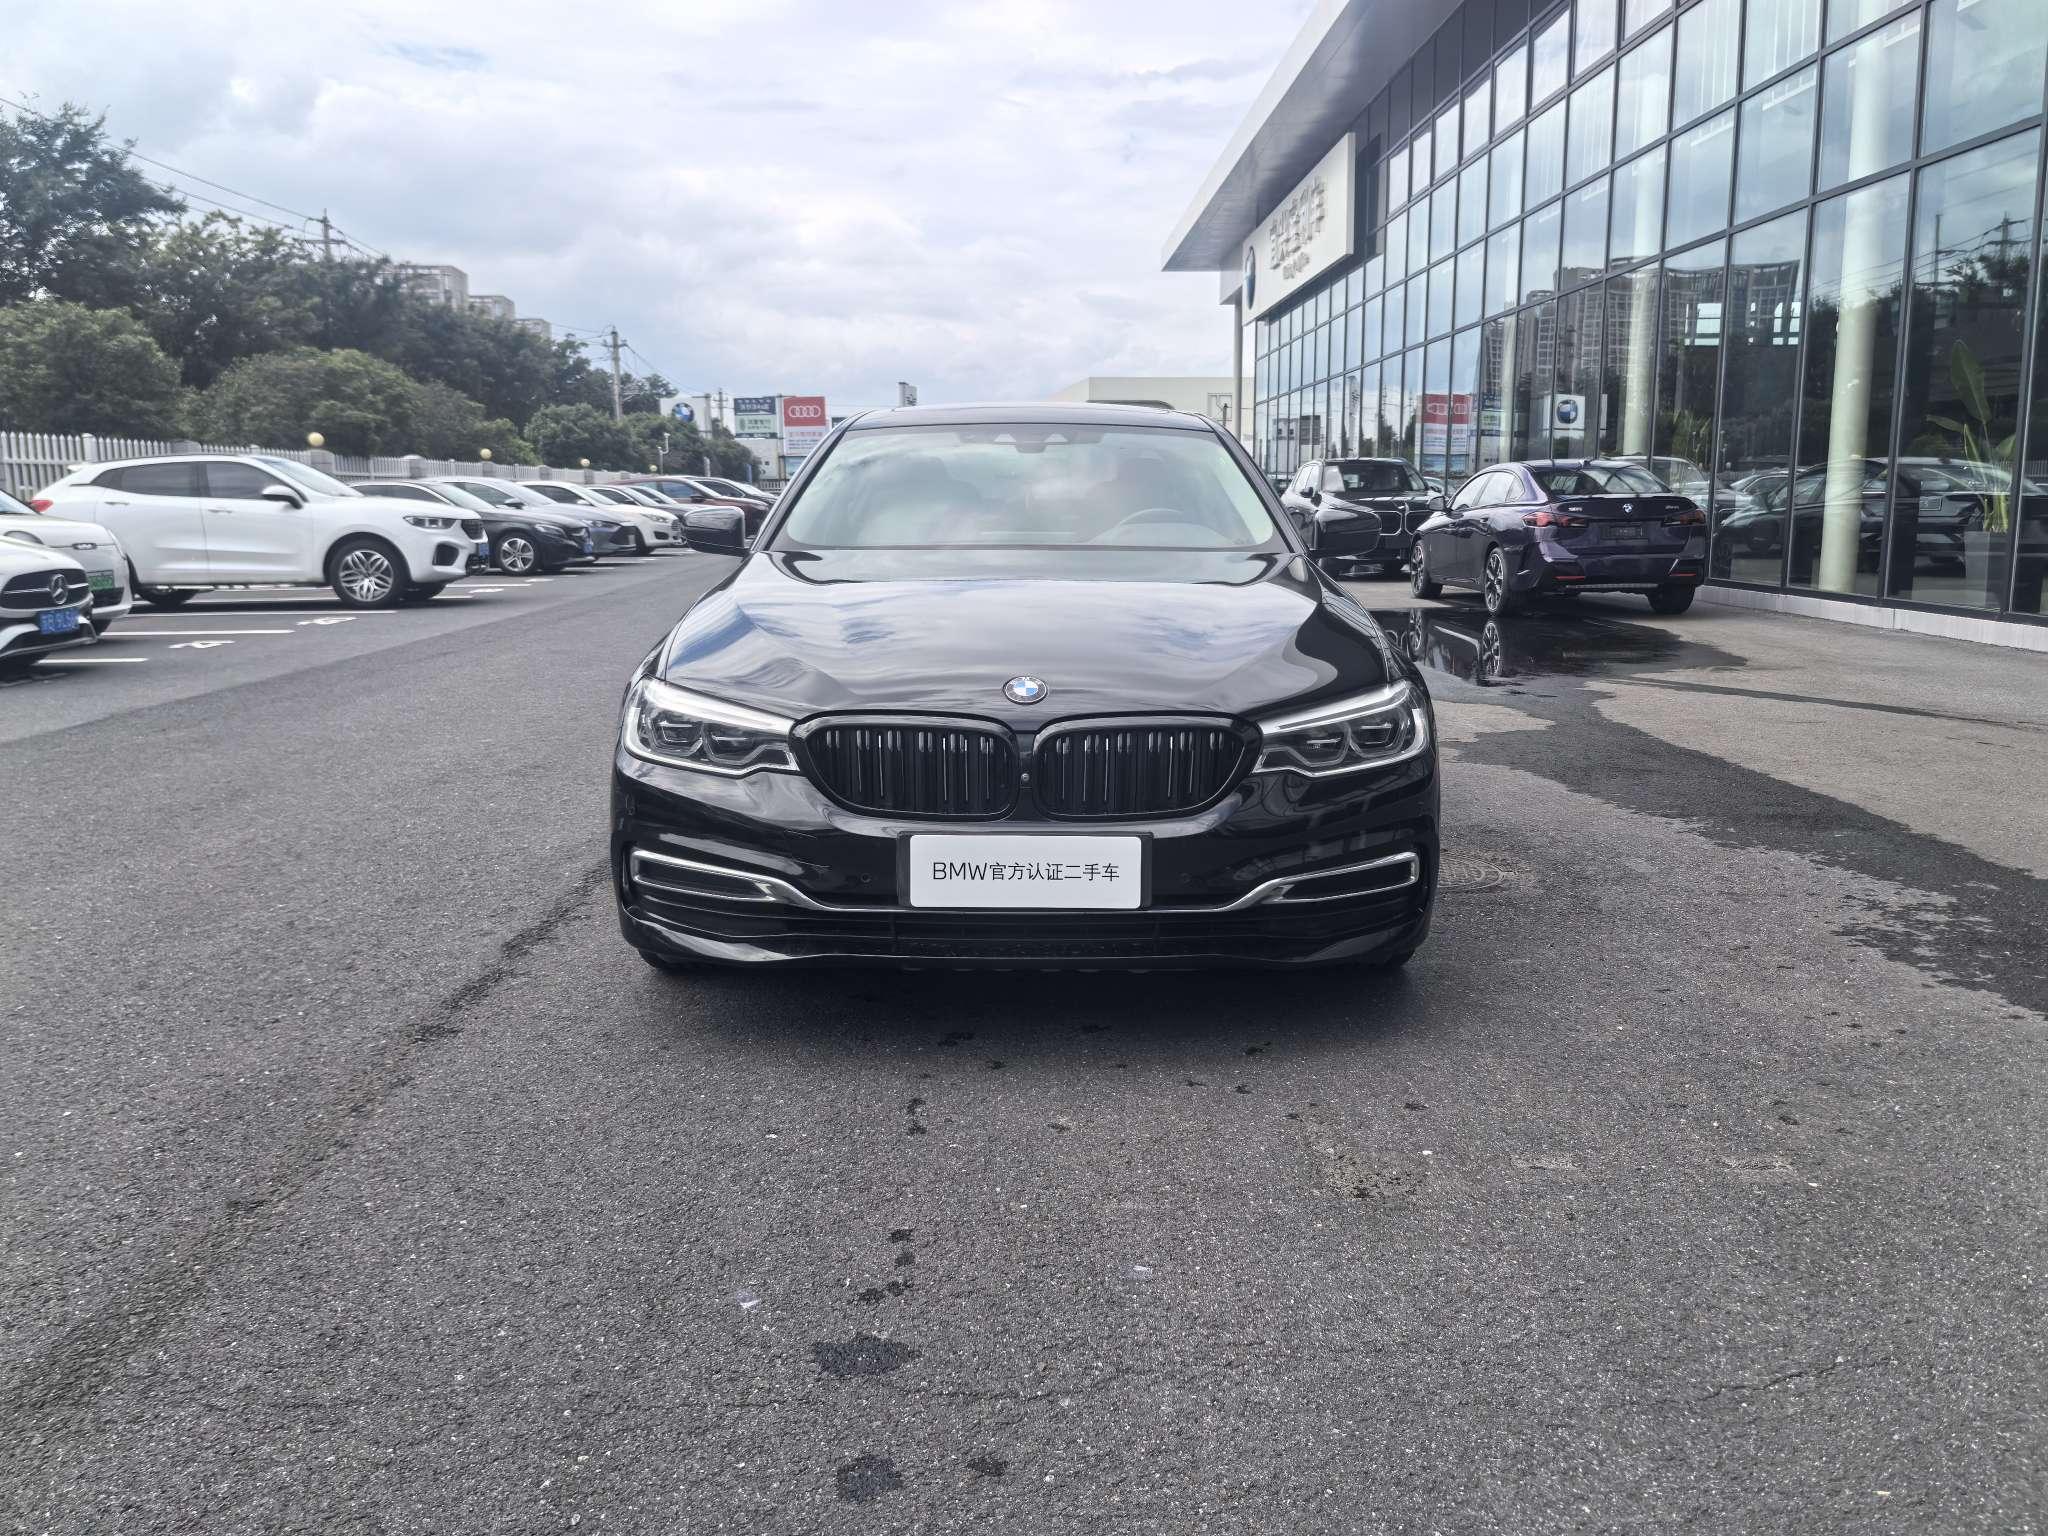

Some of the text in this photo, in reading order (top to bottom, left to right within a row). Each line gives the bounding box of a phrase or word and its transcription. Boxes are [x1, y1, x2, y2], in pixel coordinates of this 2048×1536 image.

[932, 861, 1120, 882] BMW官方认证二手车
